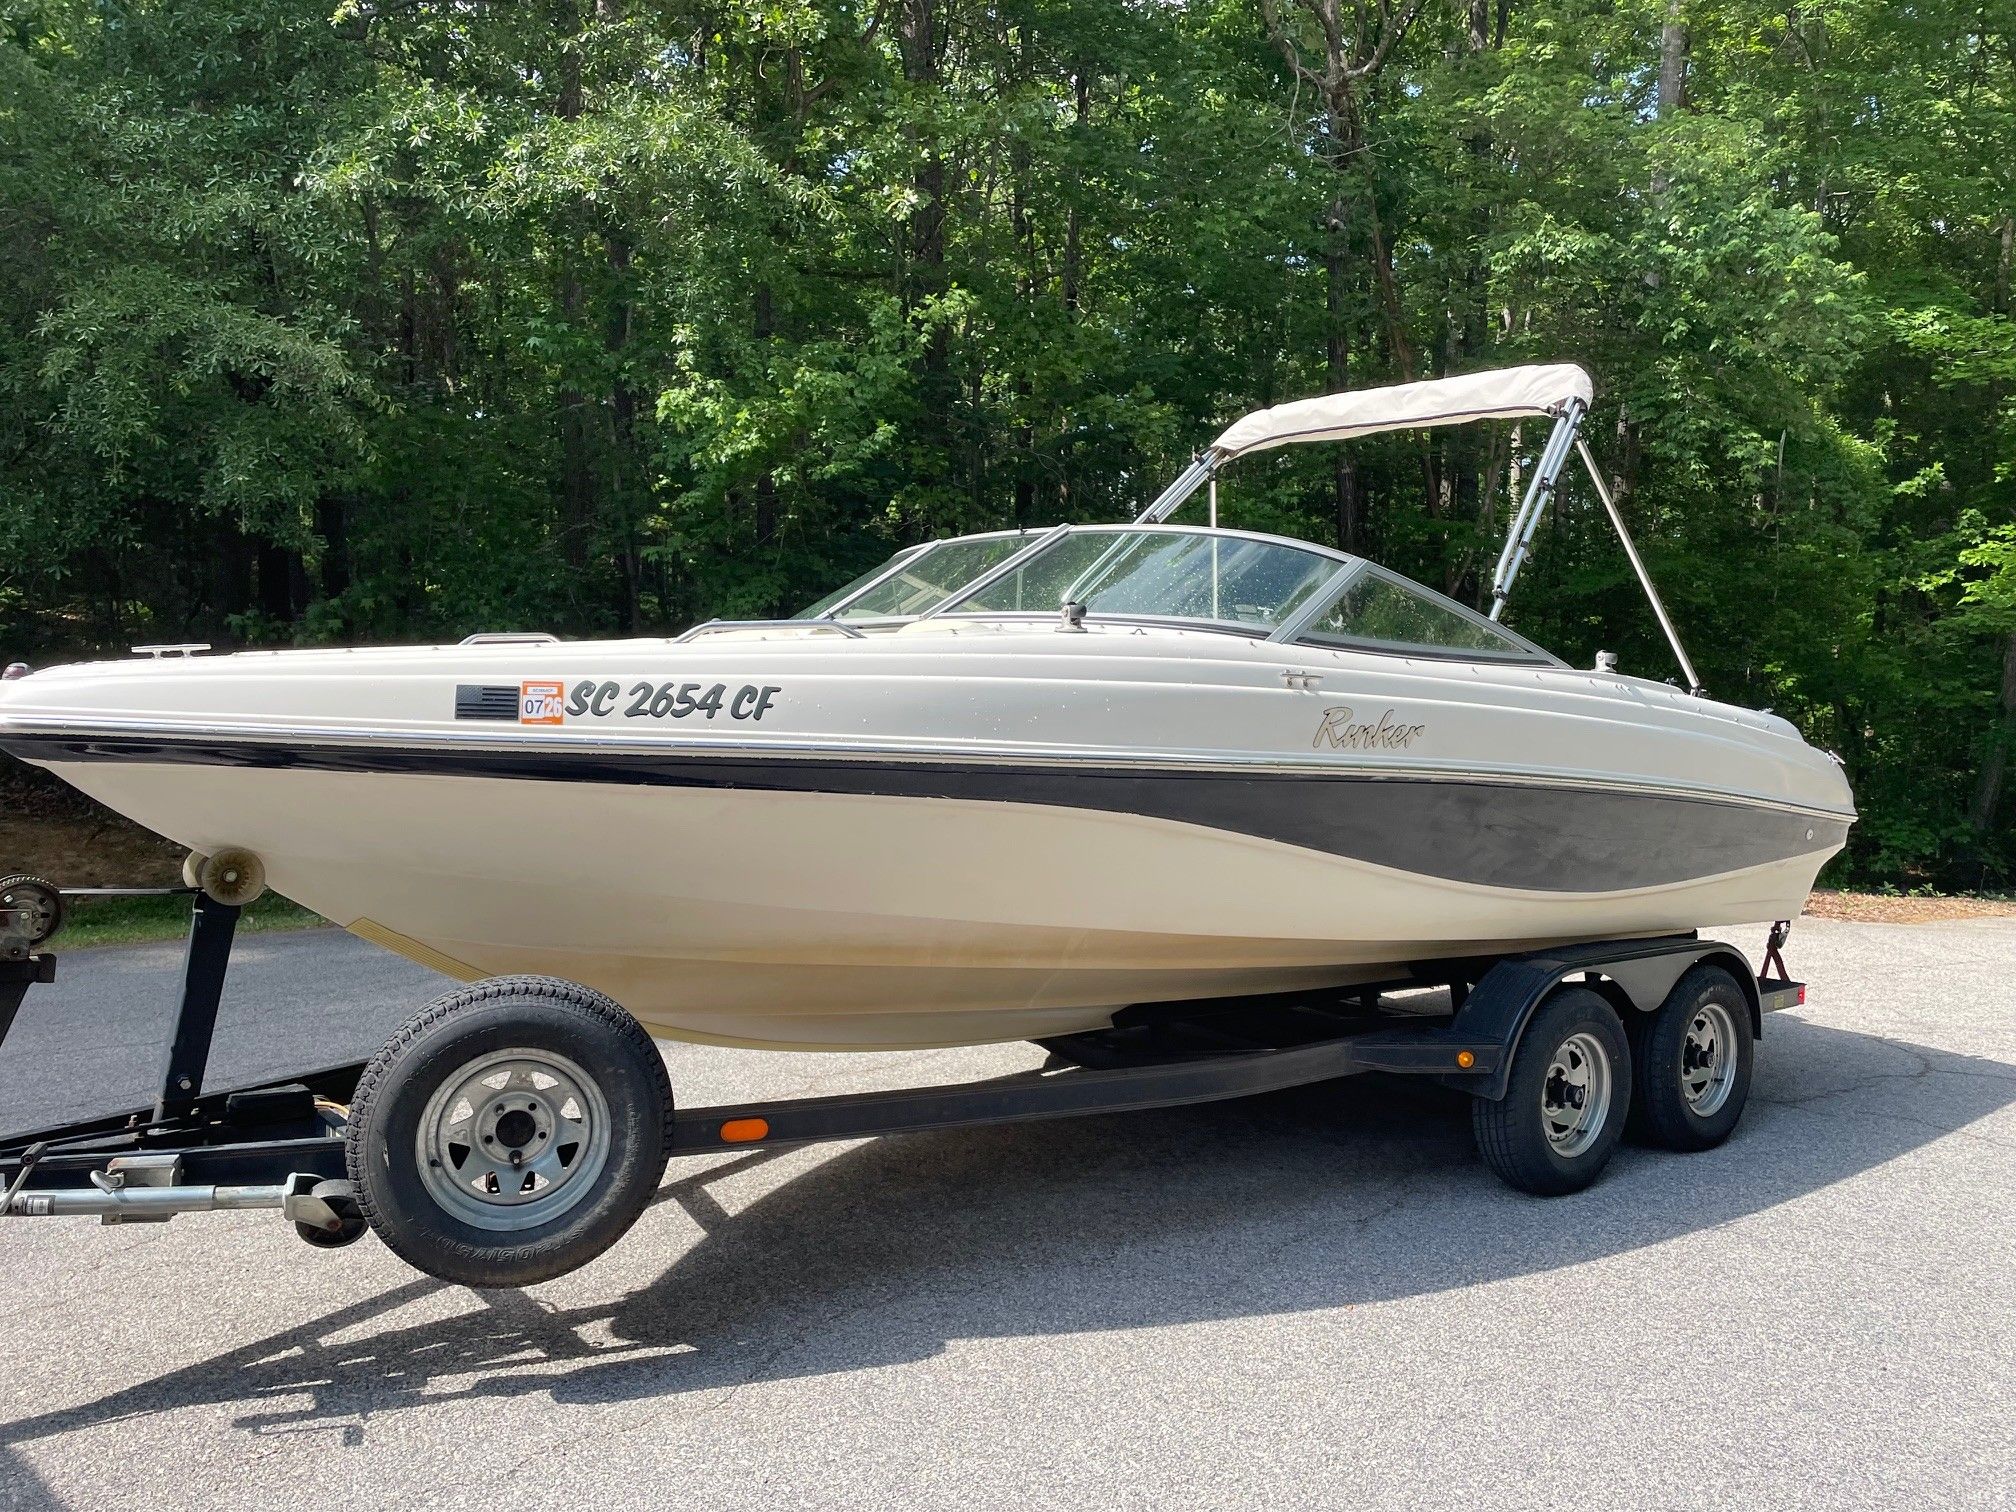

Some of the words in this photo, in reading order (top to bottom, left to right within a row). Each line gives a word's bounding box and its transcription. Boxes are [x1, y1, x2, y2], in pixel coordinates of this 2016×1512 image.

[525, 699, 544, 714] 07
[545, 696, 563, 718] 26
[564, 680, 621, 717] SC
[624, 681, 728, 719] 2654
[730, 685, 783, 720] CF
[1312, 706, 1426, 749] Rinker
